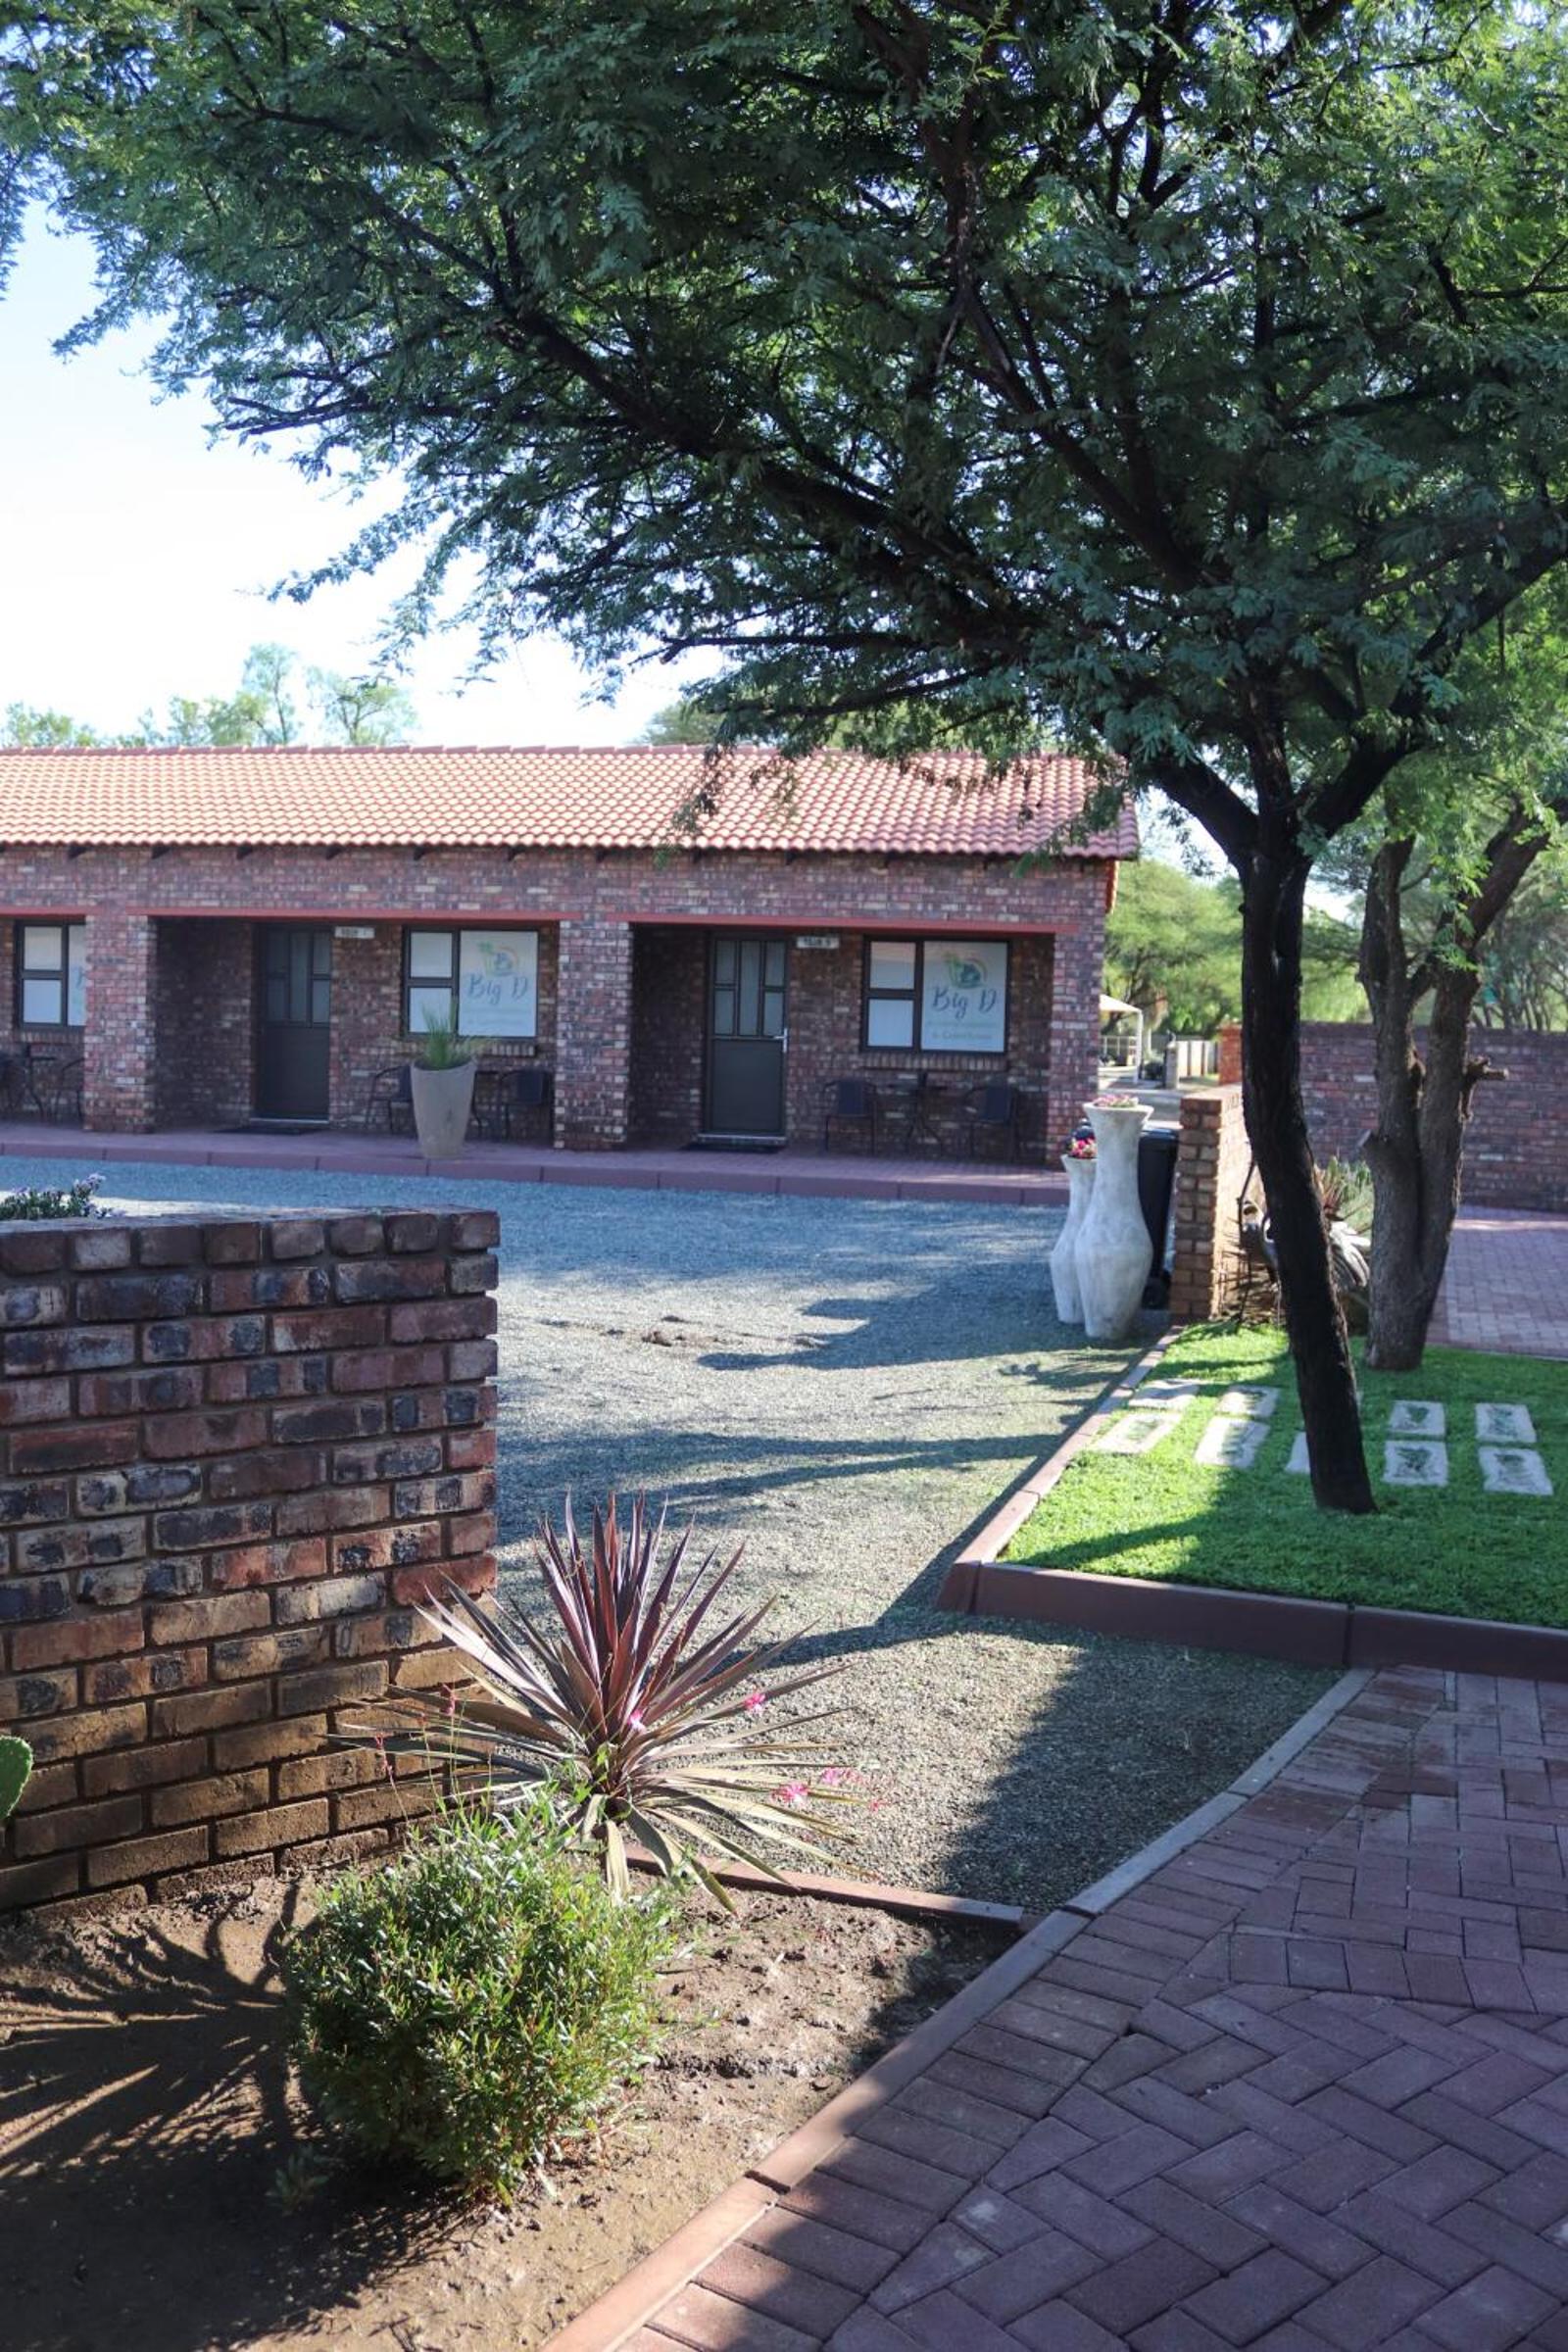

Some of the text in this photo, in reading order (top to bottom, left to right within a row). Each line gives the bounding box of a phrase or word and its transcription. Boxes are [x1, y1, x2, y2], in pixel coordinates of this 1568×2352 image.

[467, 972, 502, 1005] Big
[932, 985, 998, 1020] Big D
